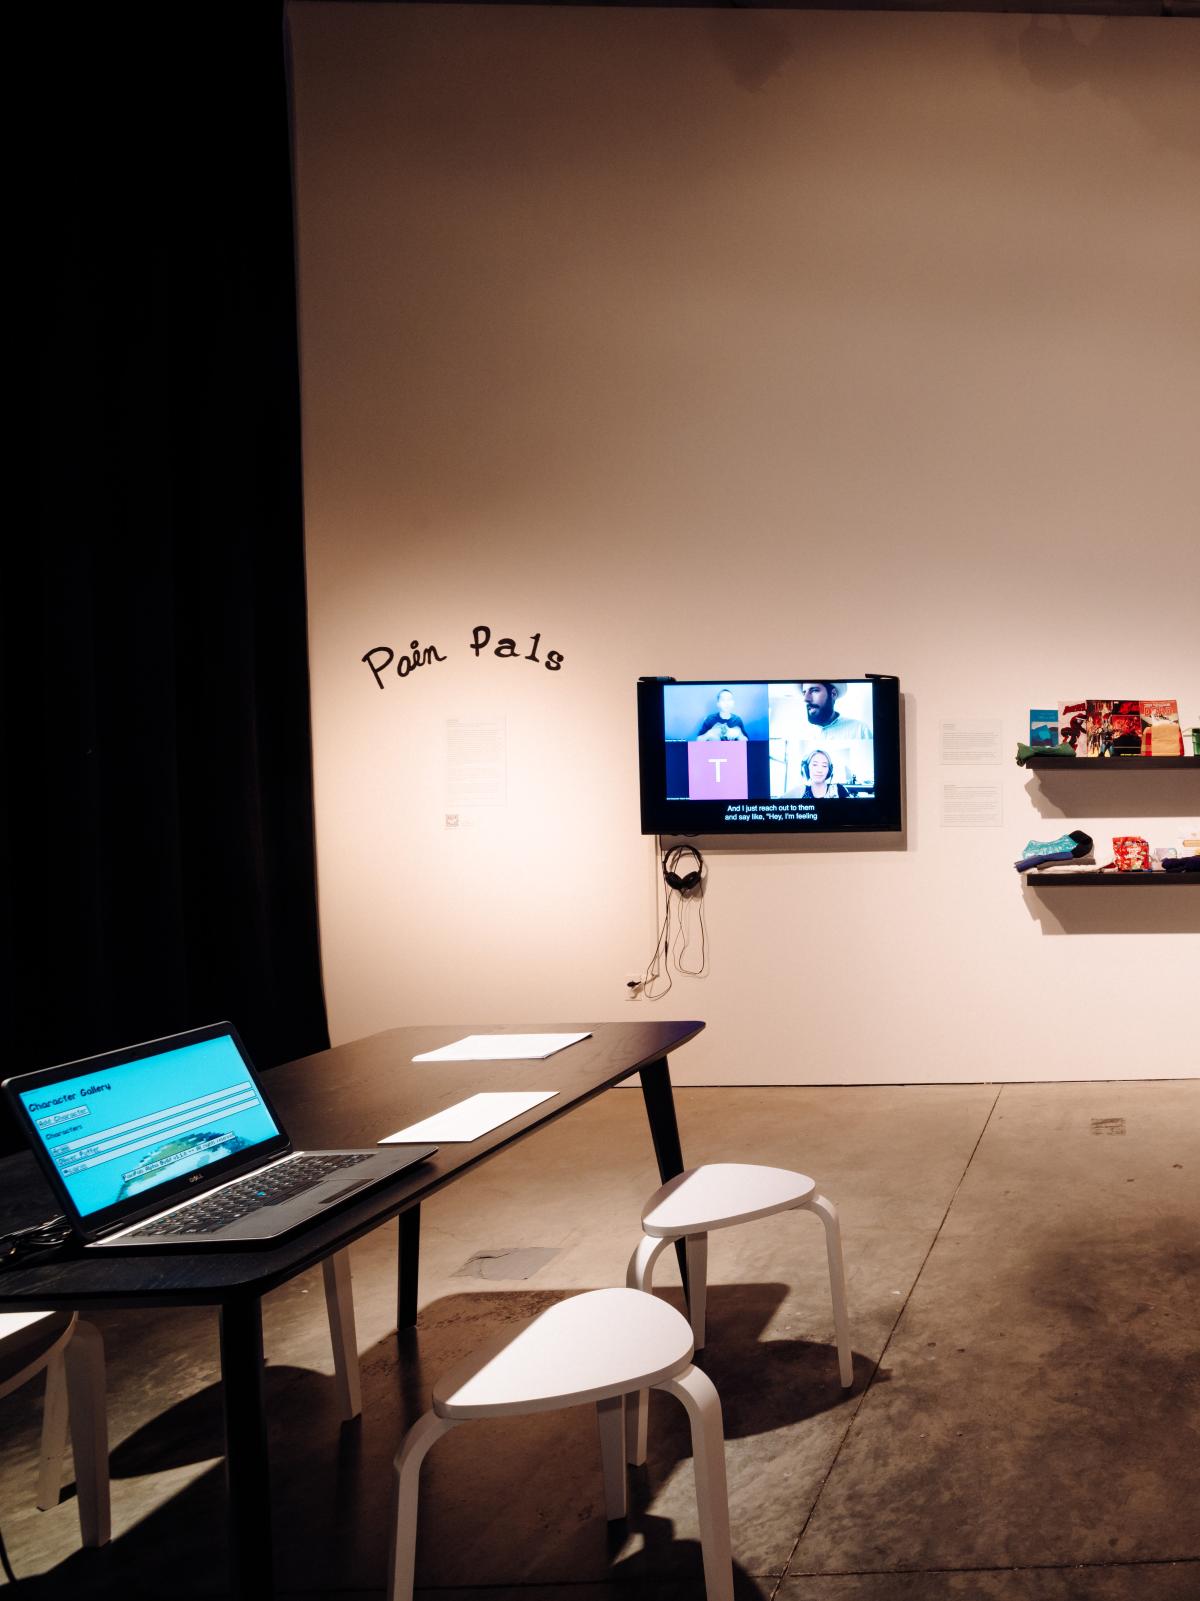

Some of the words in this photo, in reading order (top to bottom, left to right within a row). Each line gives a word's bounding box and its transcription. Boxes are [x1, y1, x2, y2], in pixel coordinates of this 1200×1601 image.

[361, 639, 447, 690] Pain
[470, 625, 564, 671] Pals
[708, 758, 728, 783] T
[745, 805, 758, 813] just
[796, 813, 818, 821] feeling
[28, 1093, 76, 1112] Character
[80, 1083, 111, 1097] Gallery
